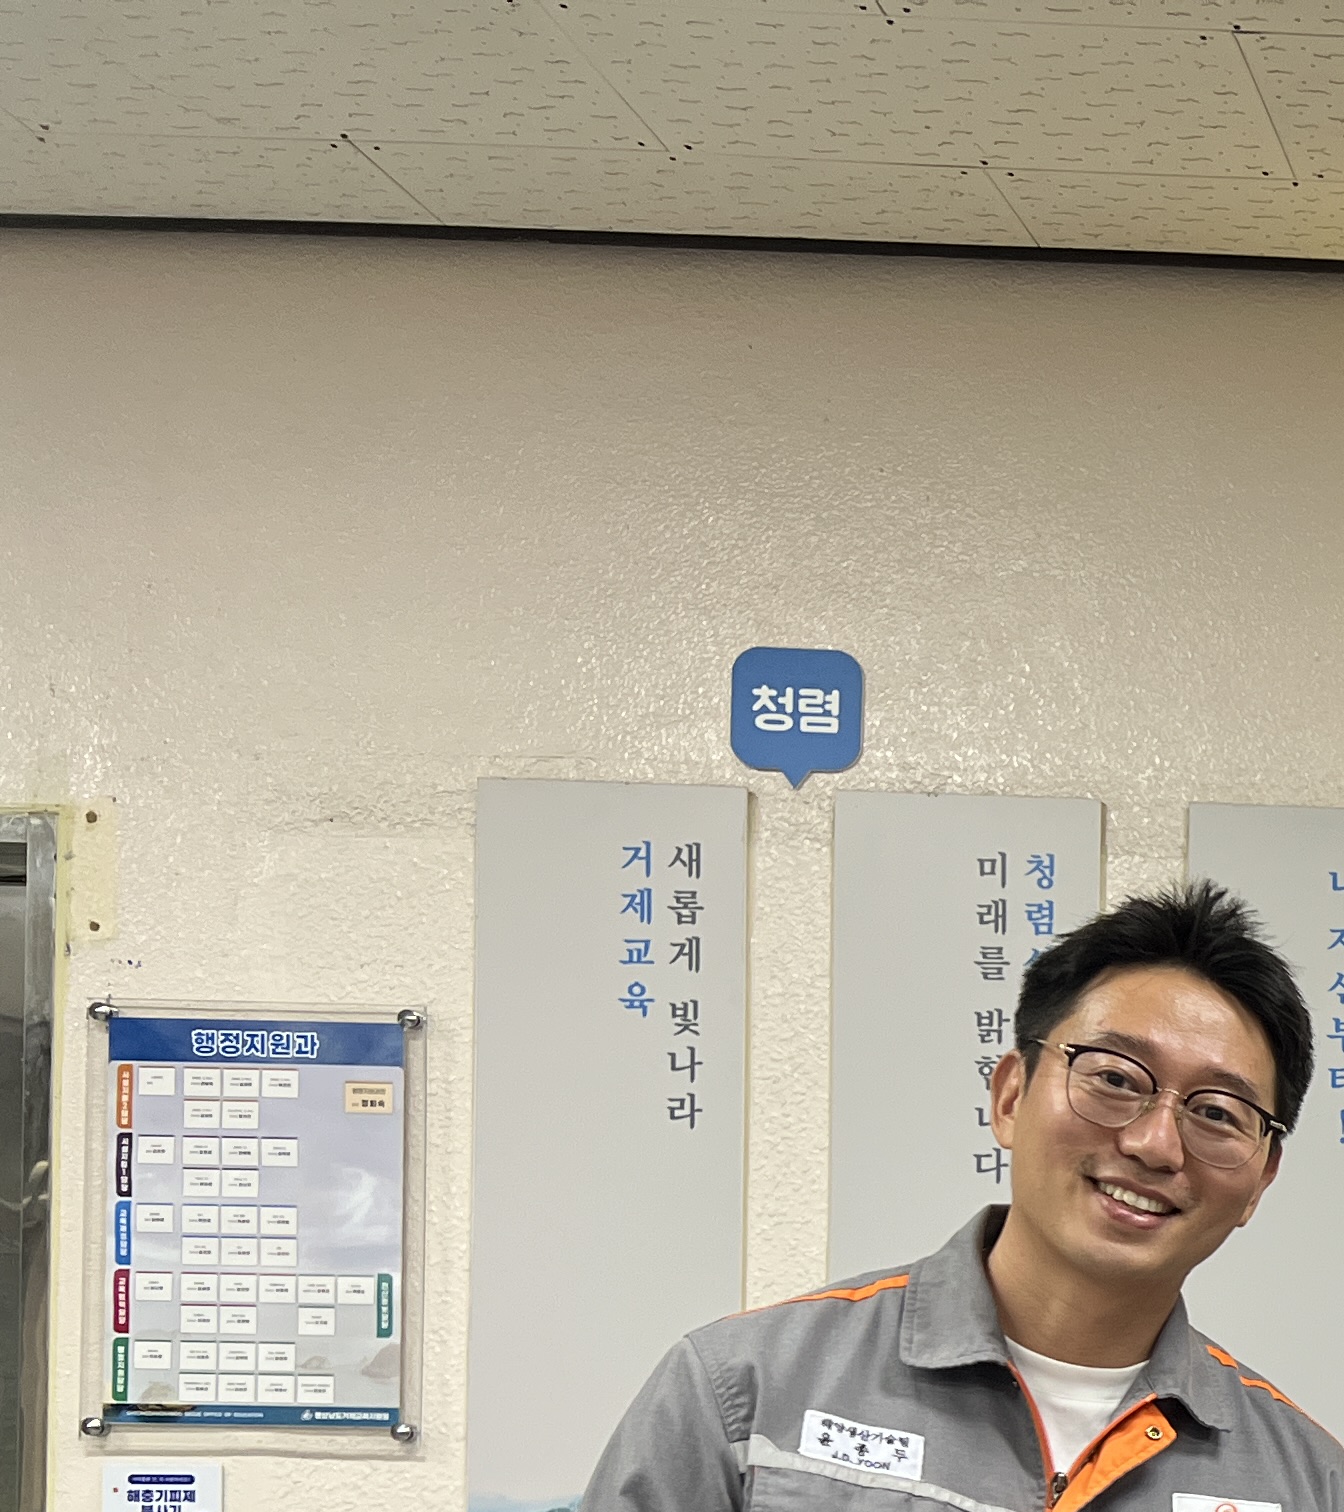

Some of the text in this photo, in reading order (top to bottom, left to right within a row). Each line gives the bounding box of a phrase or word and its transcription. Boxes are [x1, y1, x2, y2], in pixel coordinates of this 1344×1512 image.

[752, 685, 840, 734] 청렴
[618, 841, 655, 1018] 거제교육
[974, 852, 1010, 981] 미래를
[191, 1029, 319, 1058] 행정지원과
[667, 842, 705, 1130] 새롭게 빛나라
